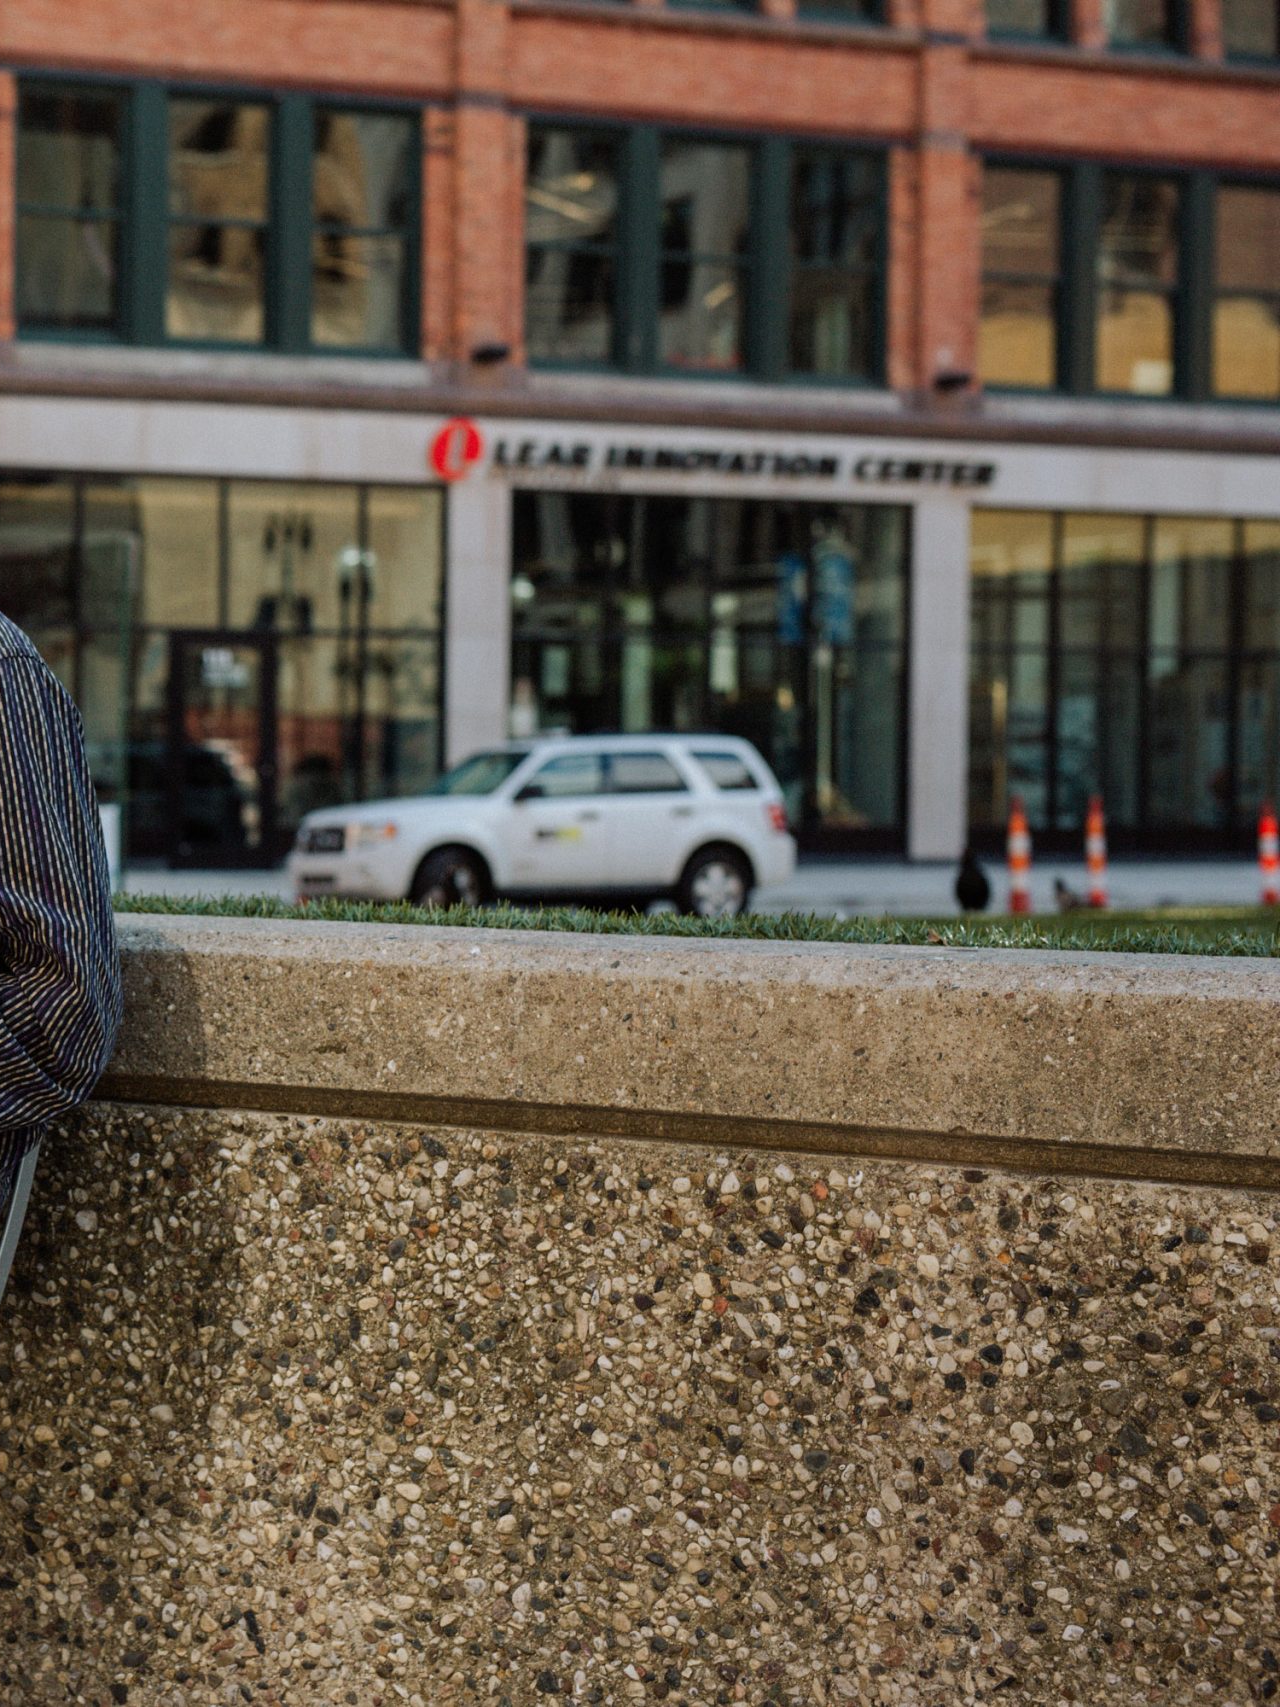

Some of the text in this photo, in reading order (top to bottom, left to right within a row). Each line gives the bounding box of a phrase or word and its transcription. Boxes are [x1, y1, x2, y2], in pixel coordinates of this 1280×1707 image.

[494, 438, 996, 485] LEAR INNOVATION CENTER
